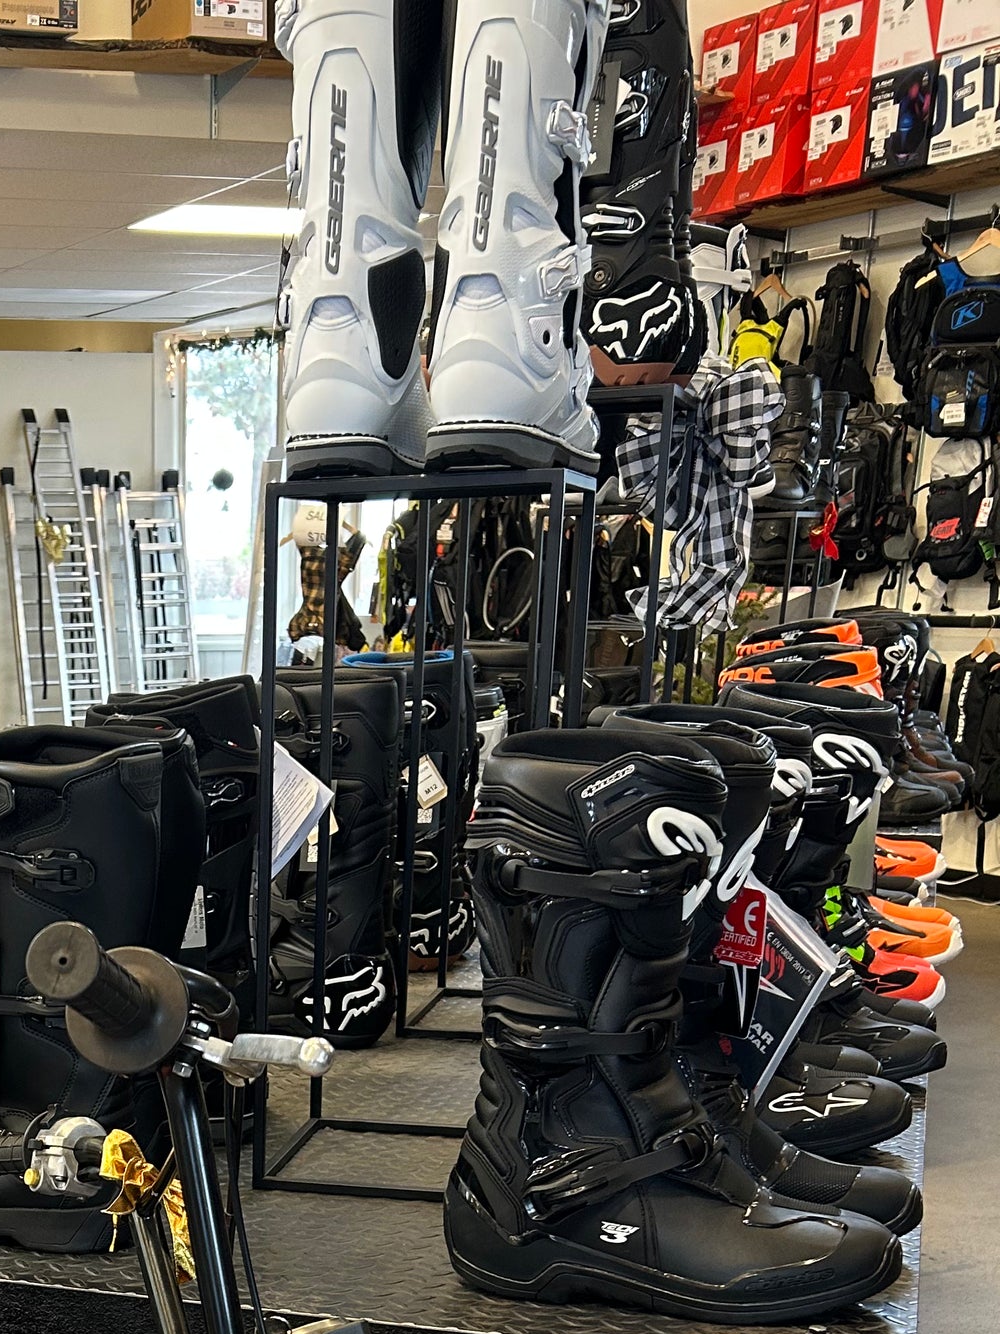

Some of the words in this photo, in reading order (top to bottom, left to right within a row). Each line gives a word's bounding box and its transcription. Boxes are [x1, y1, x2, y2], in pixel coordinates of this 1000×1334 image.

[324, 83, 347, 275] GAERNE
[472, 54, 503, 252] GAERNE
[424, 783, 438, 795] M12
[600, 1230, 628, 1244] 3
